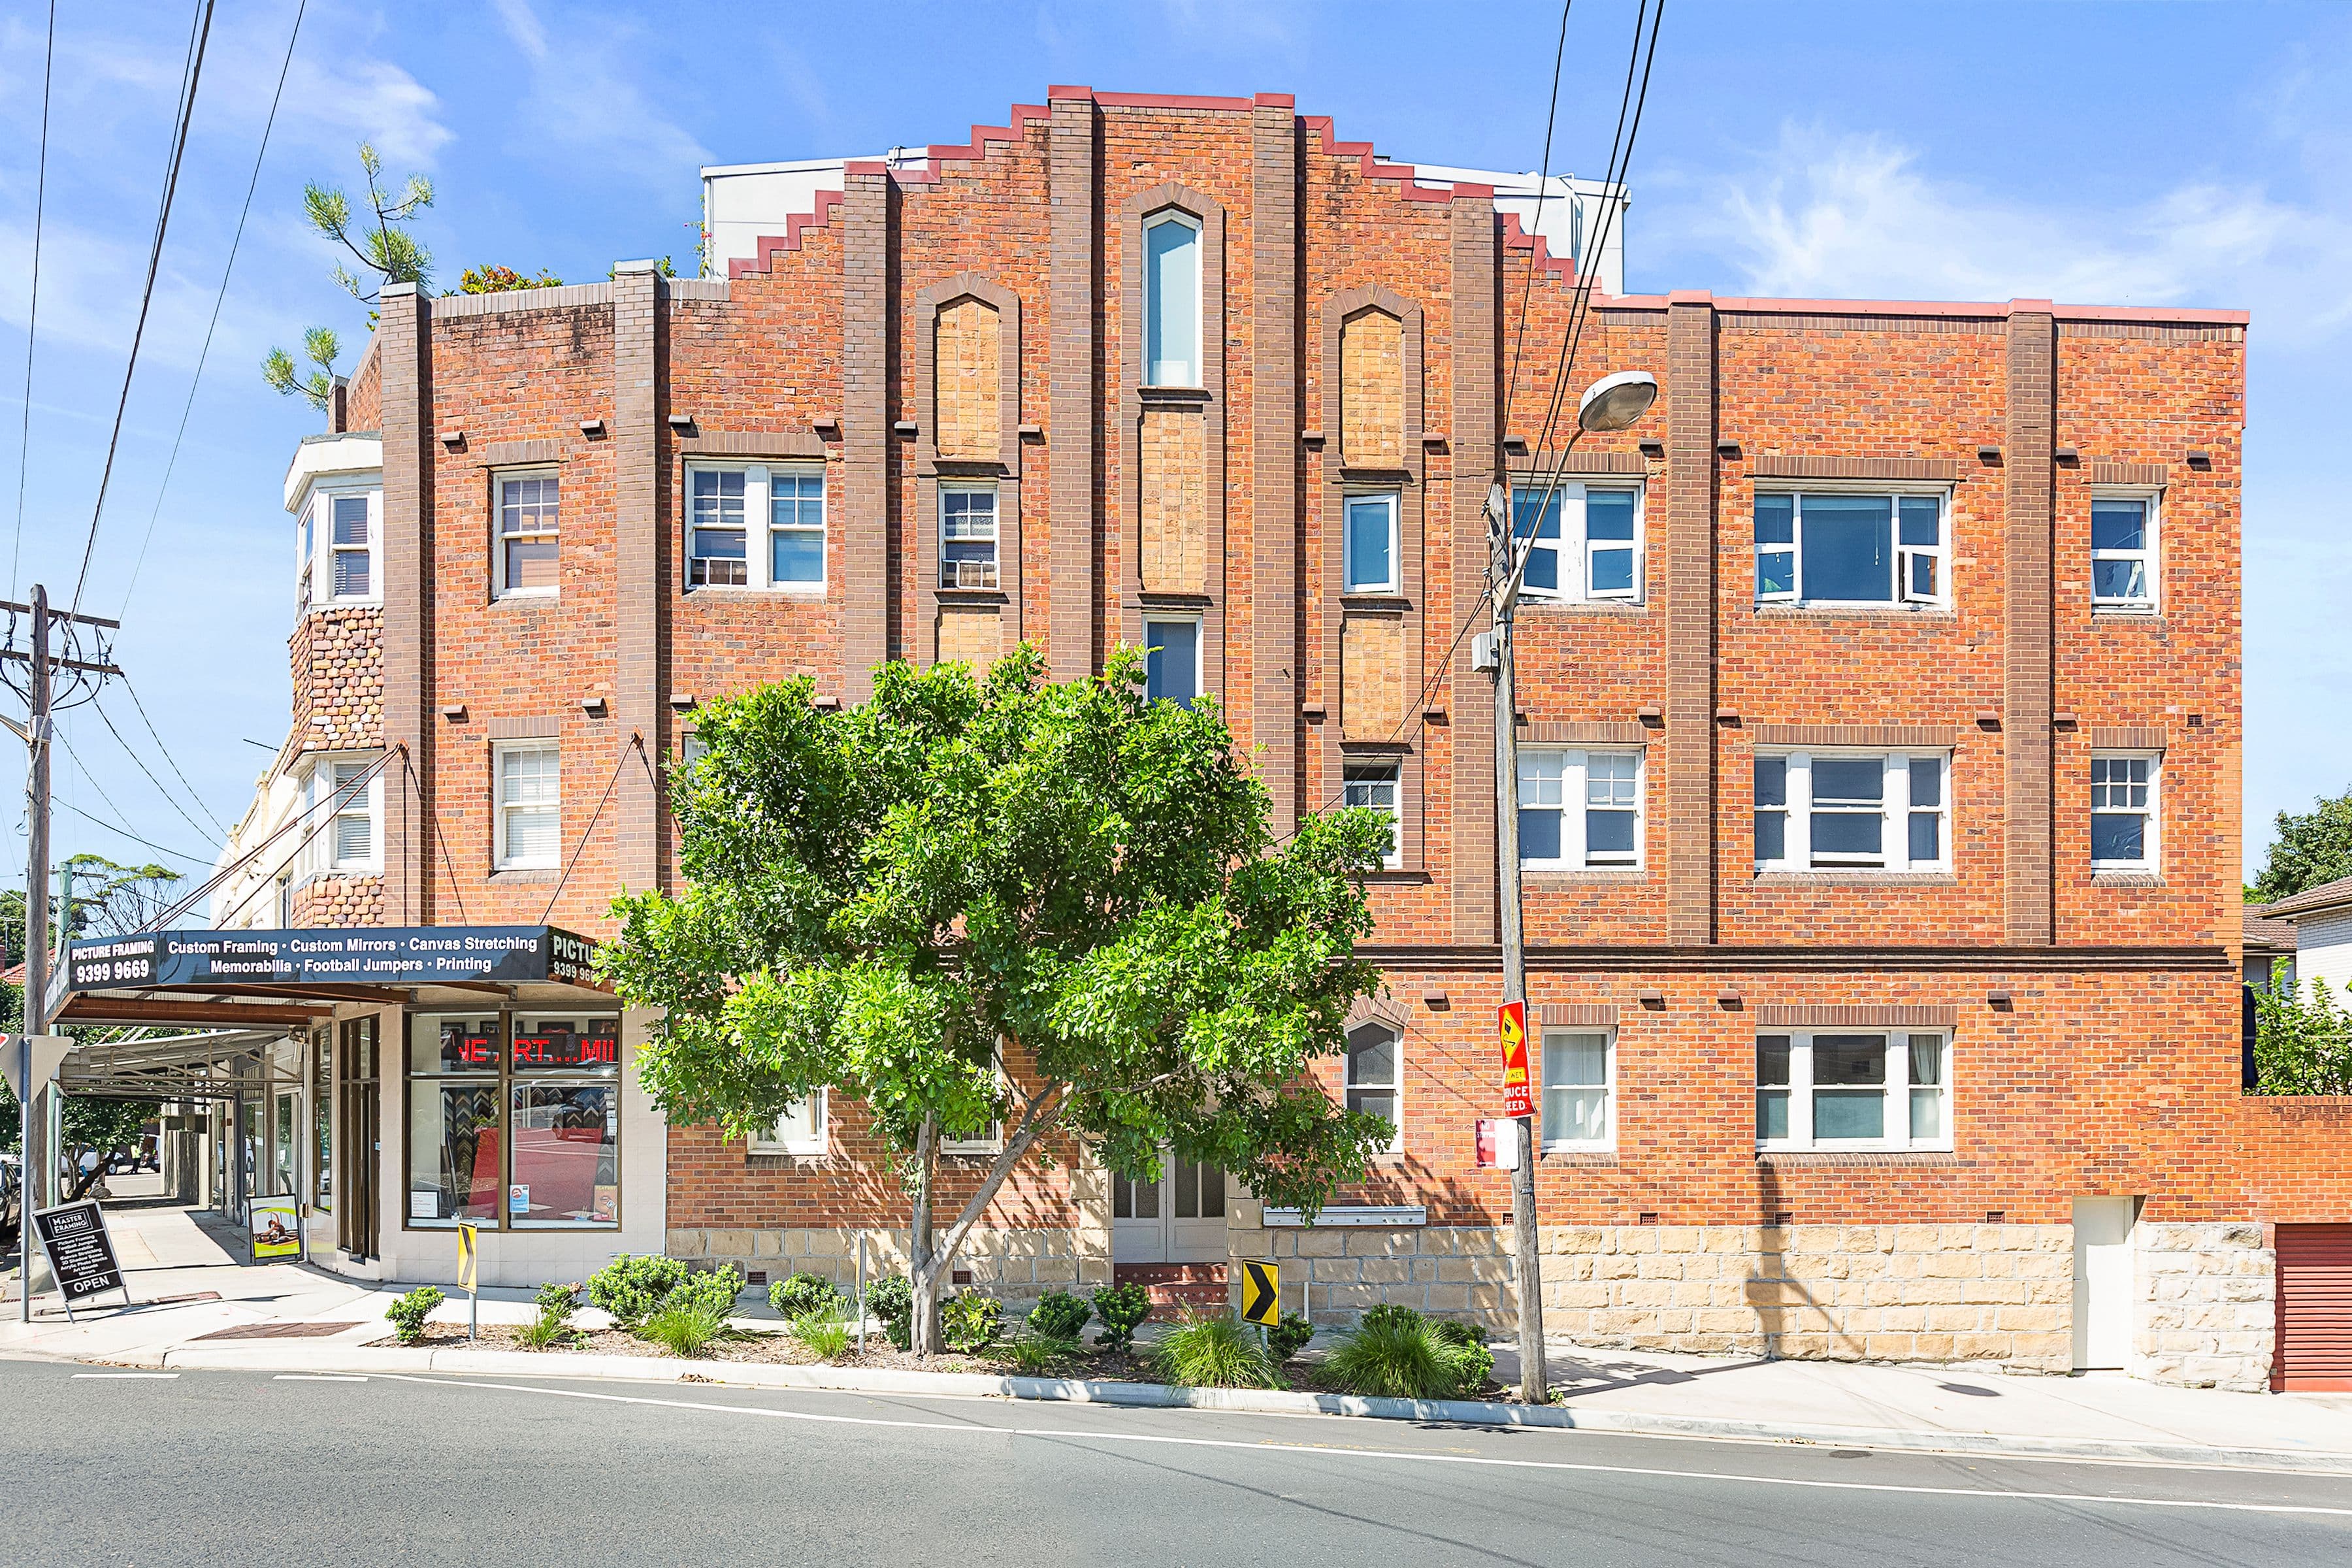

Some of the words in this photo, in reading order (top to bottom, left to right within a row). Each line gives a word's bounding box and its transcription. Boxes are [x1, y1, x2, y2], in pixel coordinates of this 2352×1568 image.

[72, 943, 111, 961] PICTURE
[112, 940, 155, 958] FRAMING
[168, 941, 220, 955] Custom
[223, 939, 278, 956] Framing
[290, 939, 343, 953] Custom
[346, 937, 397, 952] Mirrors
[409, 937, 461, 951] Canvas
[465, 935, 538, 953] Stretching
[553, 935, 597, 964] PICTU
[76, 962, 111, 983] 9399
[114, 958, 150, 981] 9669
[210, 959, 292, 973] Memorabilia
[304, 958, 360, 972] Football
[363, 958, 423, 974] Jumpers
[436, 956, 492, 973] Printing
[553, 961, 577, 979] 9399
[52, 1215, 83, 1226] MASTER
[54, 1220, 87, 1233] FRAMING
[73, 1275, 110, 1293] OPEN
